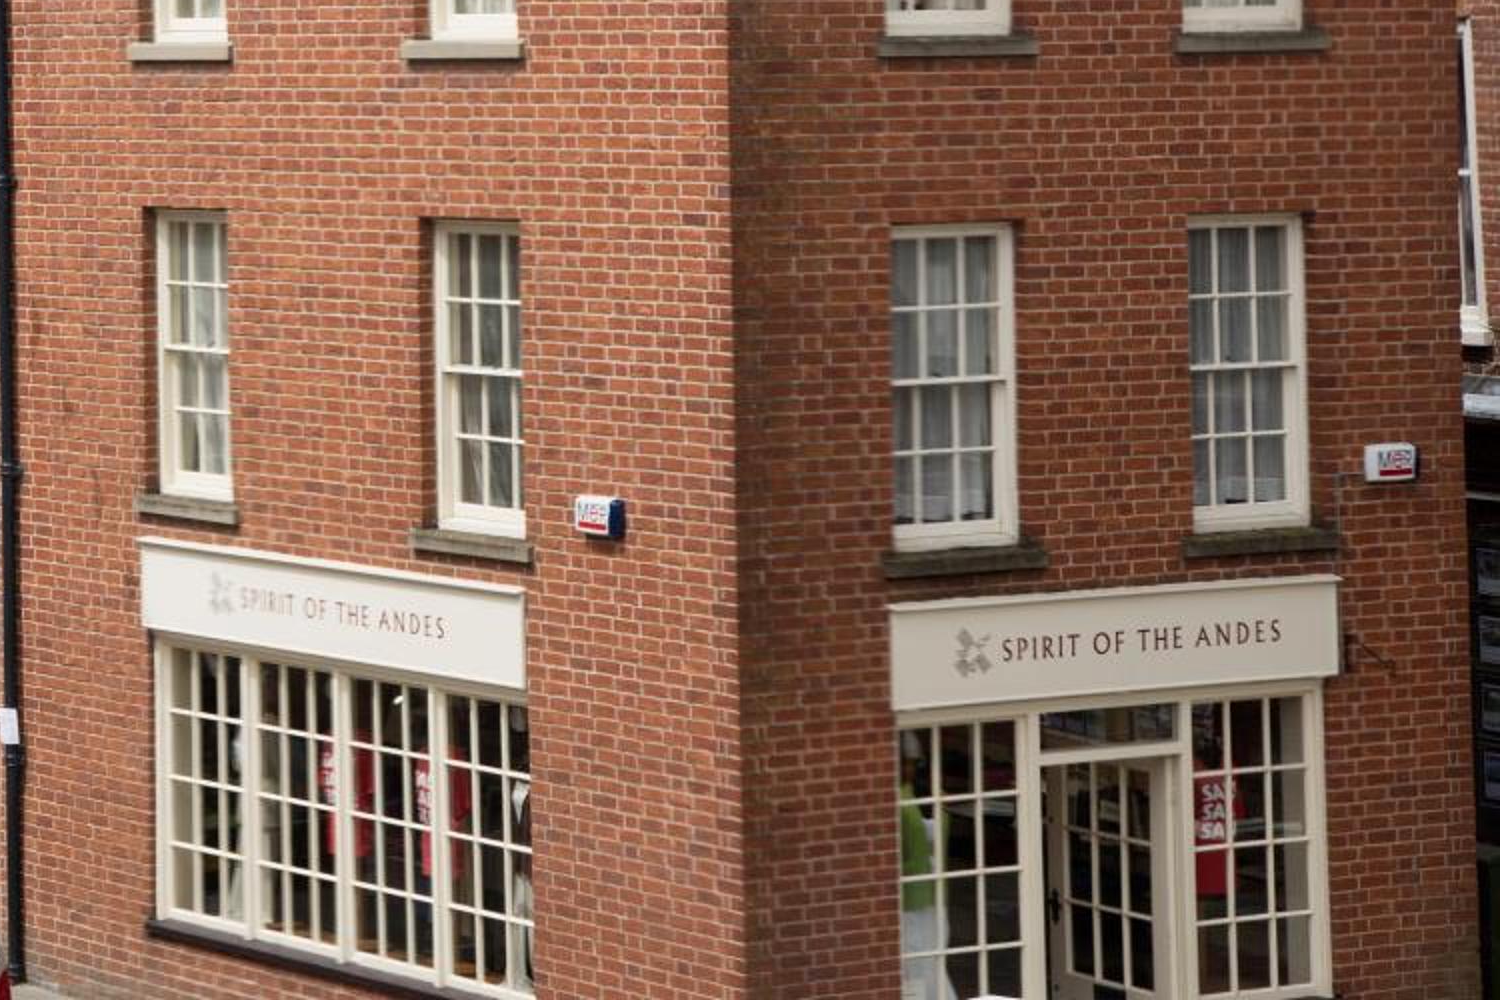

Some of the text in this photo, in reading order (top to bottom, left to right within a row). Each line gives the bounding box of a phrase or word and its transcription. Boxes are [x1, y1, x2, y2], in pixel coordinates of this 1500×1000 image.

[241, 585, 446, 640] SPIRIT OF THE ANDES
[1001, 618, 1282, 662] SPIRIT OF THE ANDES
